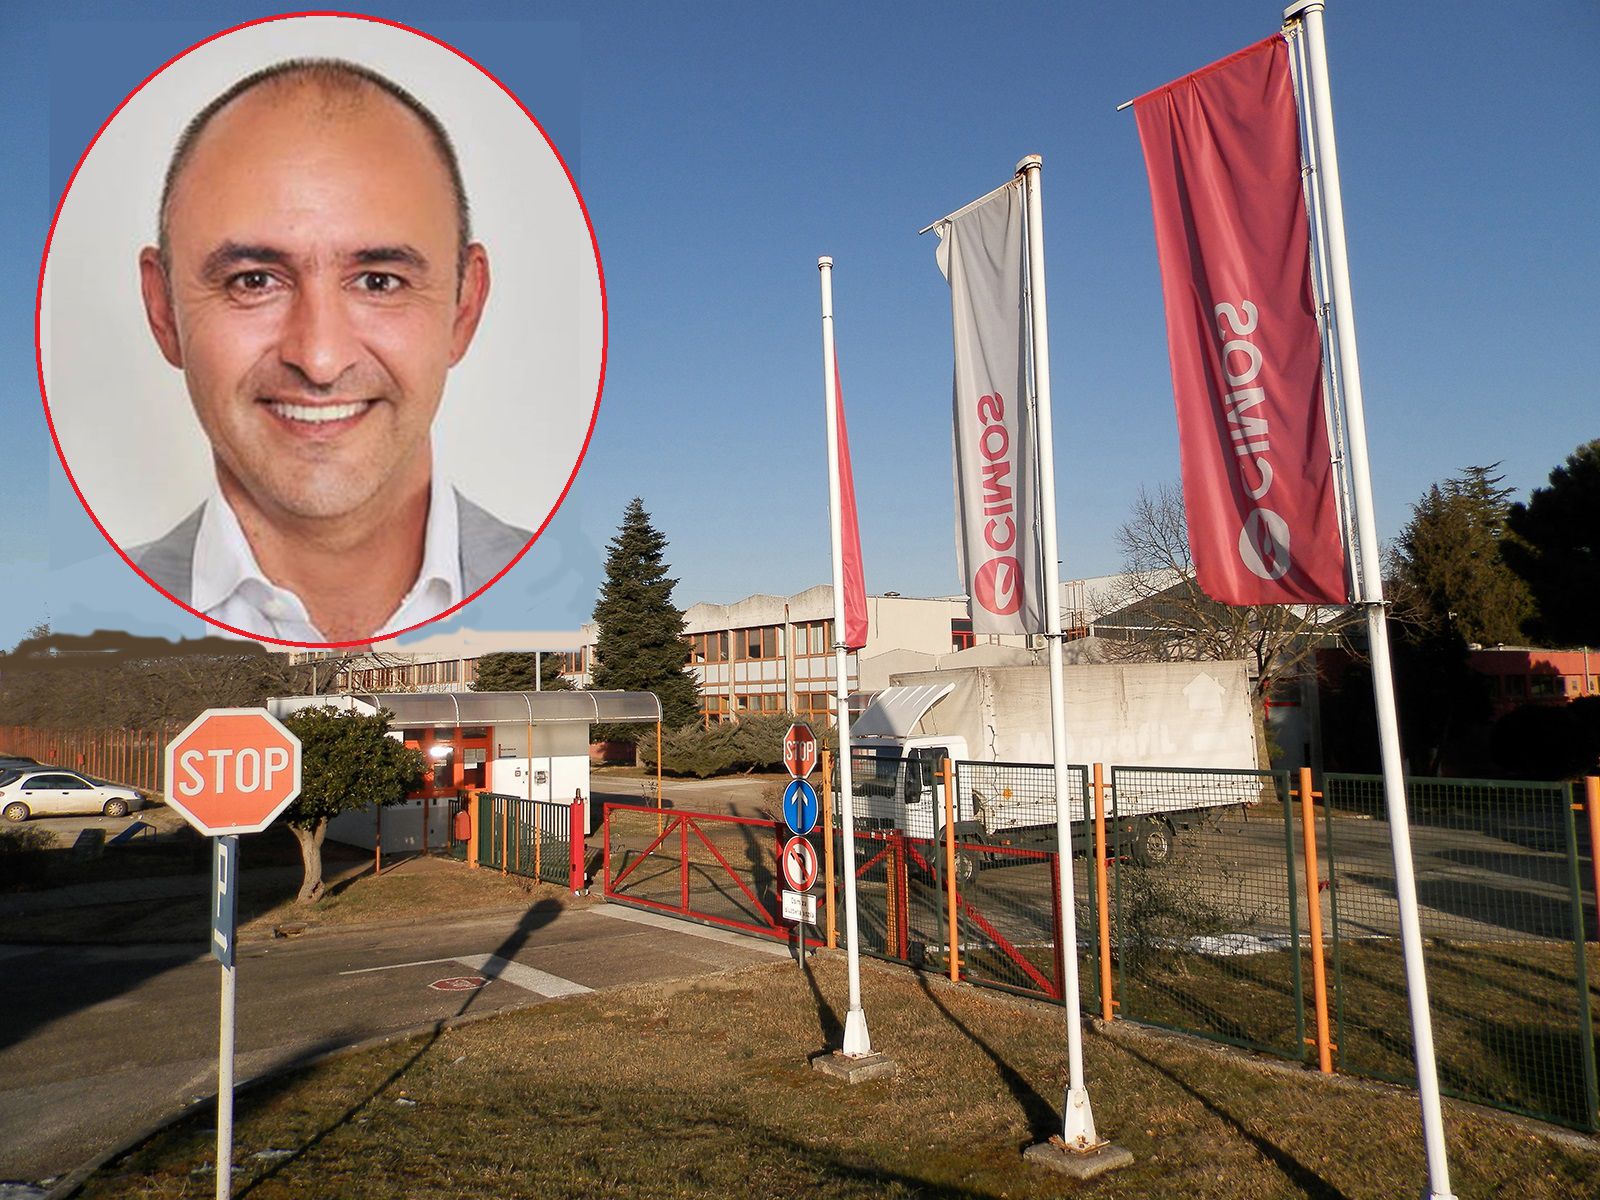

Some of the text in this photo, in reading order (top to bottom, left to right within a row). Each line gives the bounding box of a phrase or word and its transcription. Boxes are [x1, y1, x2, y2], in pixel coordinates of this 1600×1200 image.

[178, 747, 289, 796] STOP
[786, 740, 814, 761] STOP
[217, 842, 228, 917] P
